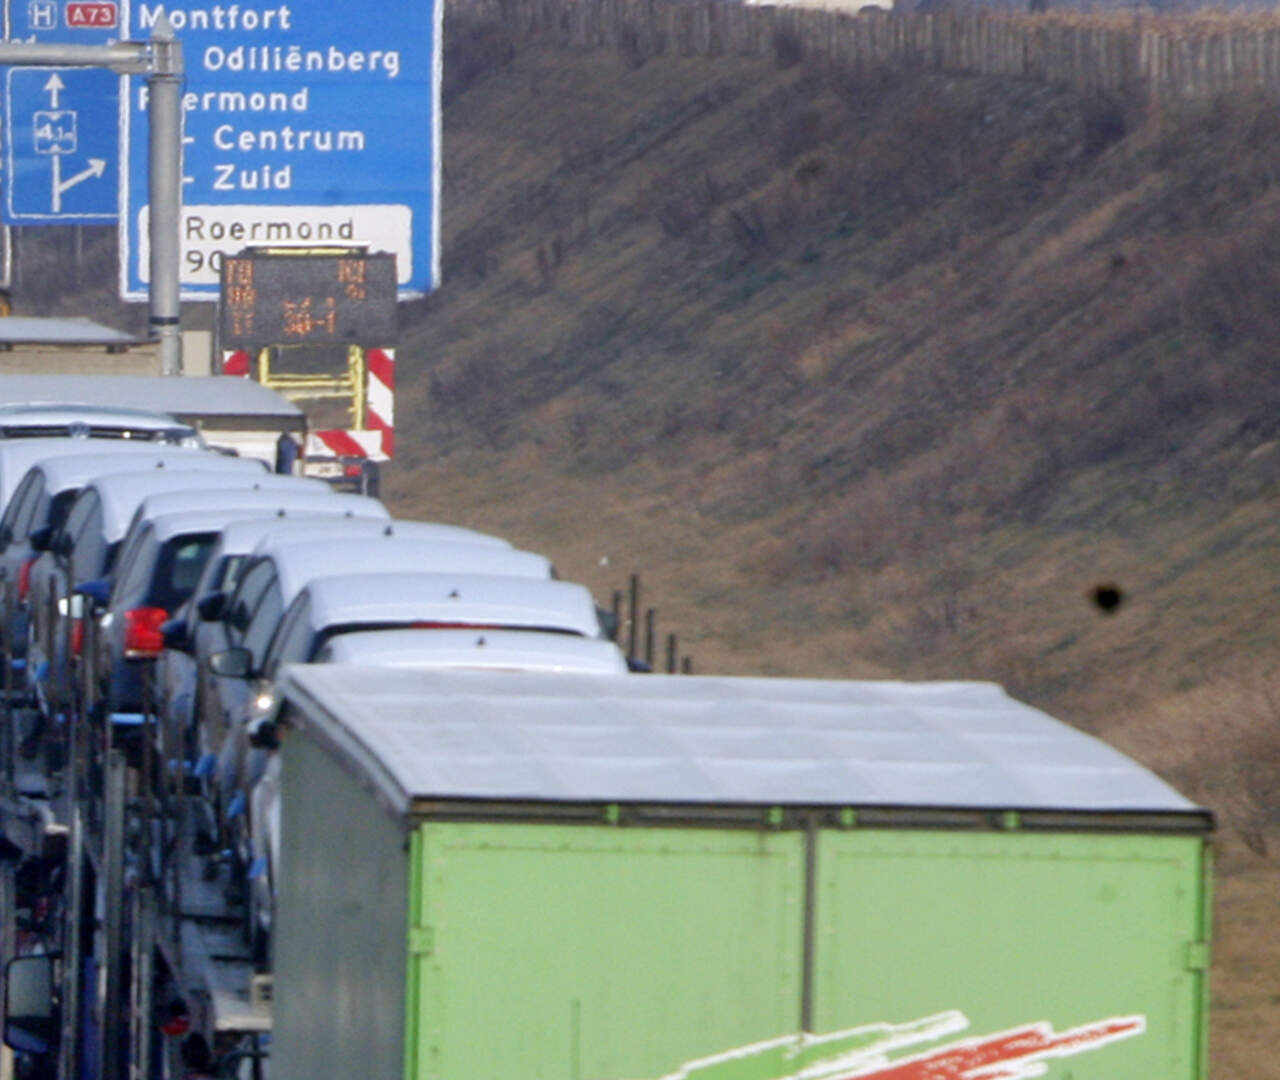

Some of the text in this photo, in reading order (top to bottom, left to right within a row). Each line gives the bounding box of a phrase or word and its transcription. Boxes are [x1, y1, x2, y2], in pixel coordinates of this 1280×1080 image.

[72, 7, 112, 24] A73
[139, 4, 291, 30] Montfort
[203, 46, 400, 78] Odiliënberg
[213, 125, 365, 150] Centrum
[213, 165, 291, 190] Zuid
[185, 216, 355, 241] Roermond
